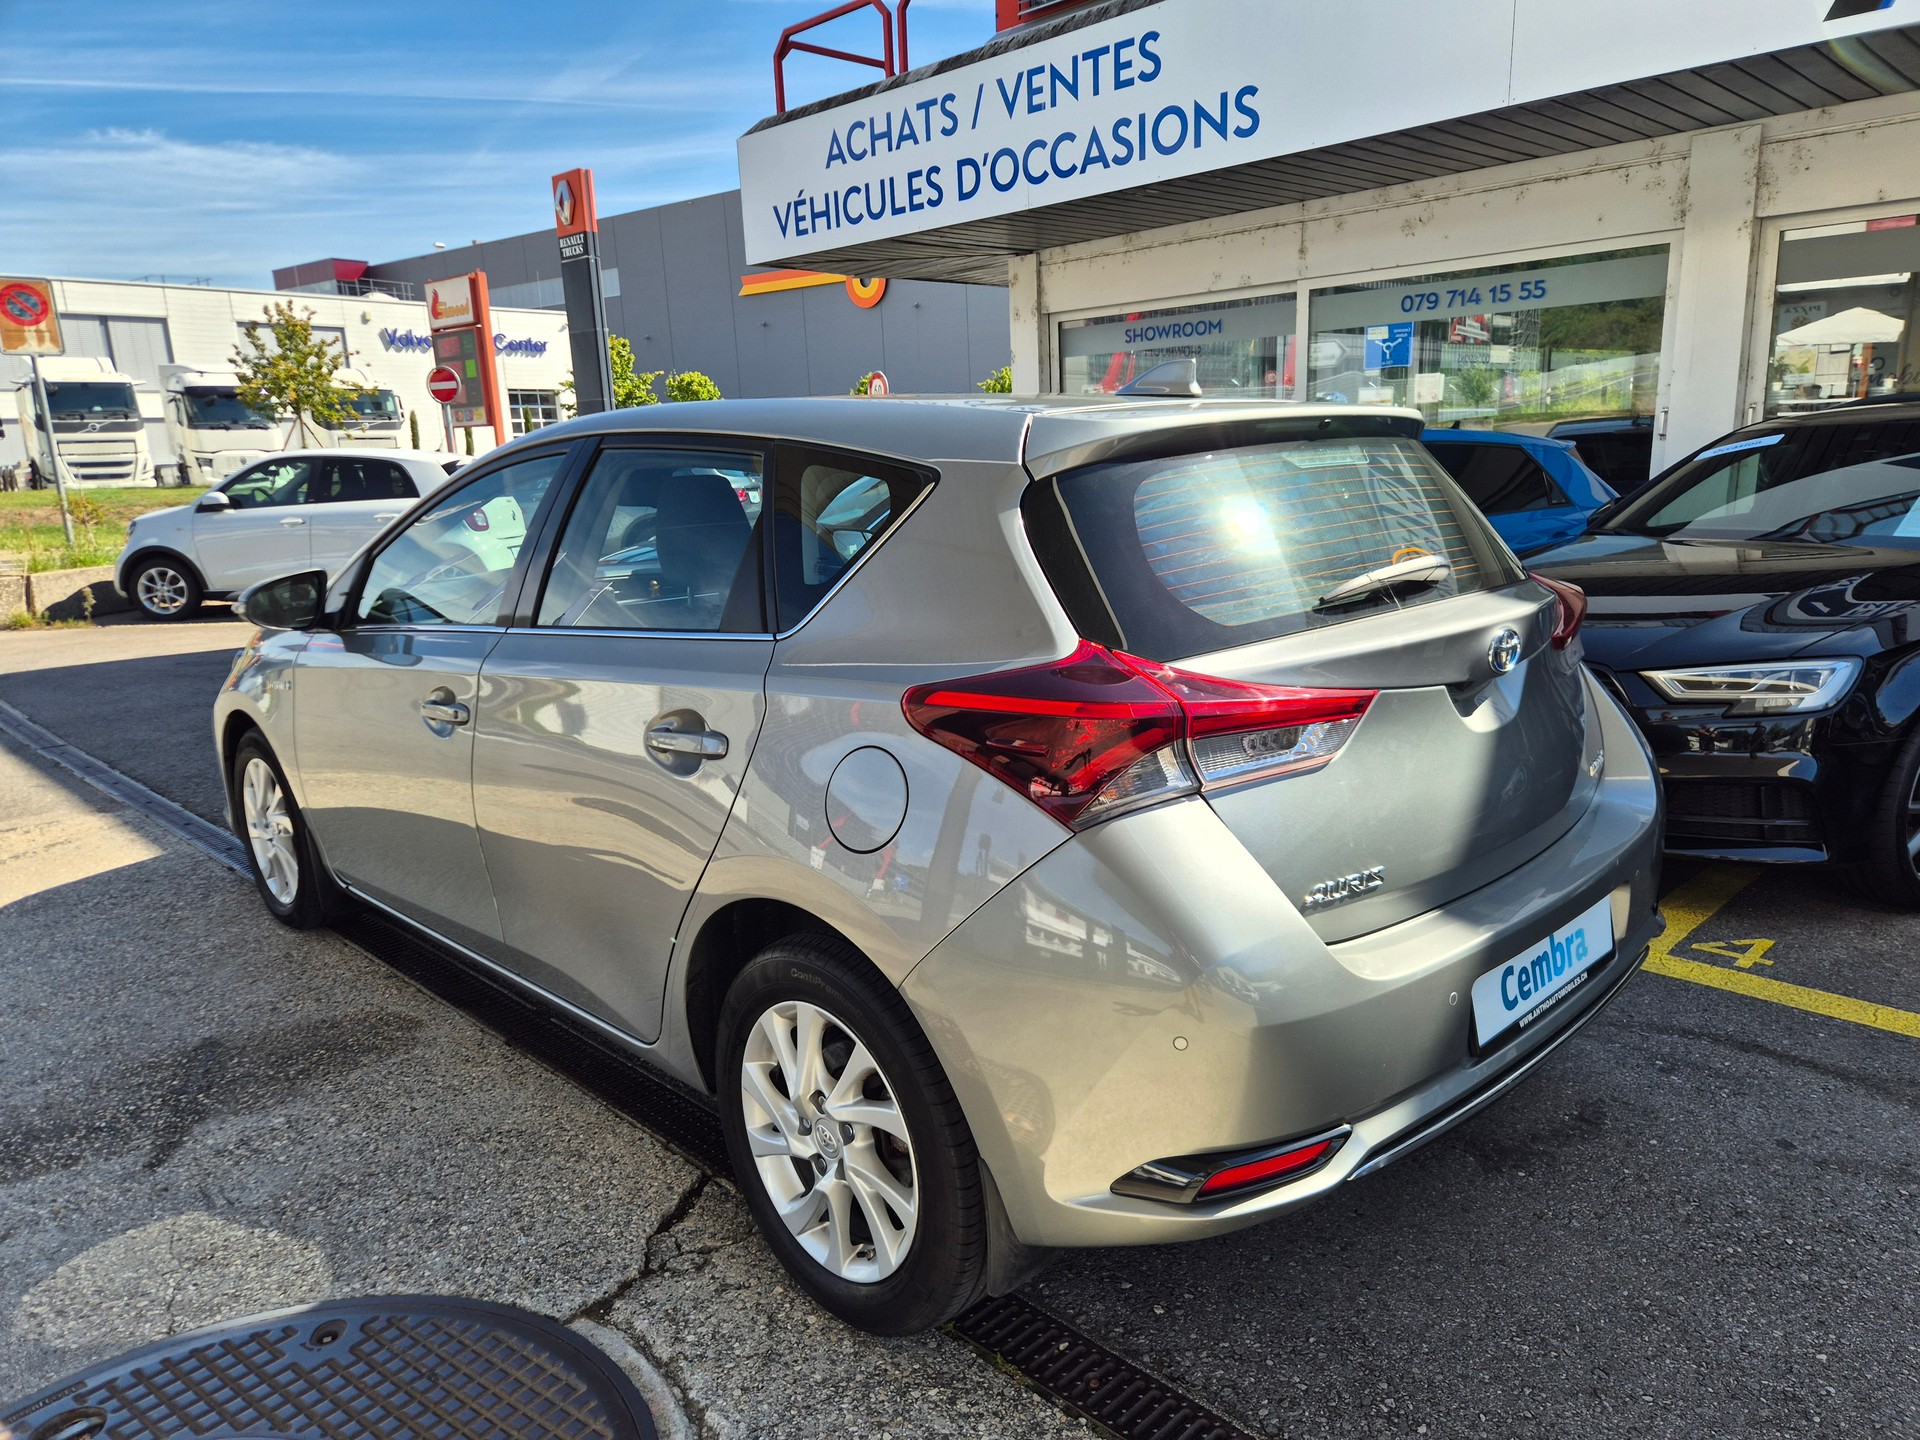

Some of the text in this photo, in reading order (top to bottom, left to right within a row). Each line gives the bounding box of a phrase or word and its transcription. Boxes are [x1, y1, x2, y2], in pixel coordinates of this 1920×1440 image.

[825, 30, 1163, 169] ACHATS / VENTES
[772, 84, 1262, 240] VÉHICULES D'OCCASIONS
[560, 234, 584, 248] RENAULT
[561, 244, 584, 257] TRUCKS
[1400, 279, 1546, 313] 079 714 15 55
[384, 327, 549, 352] Volvo Center
[1124, 318, 1223, 344] SHOWROOM
[1304, 866, 1385, 906] AURIS
[1691, 938, 1776, 969] 4
[1500, 928, 1588, 1012] Cembra
